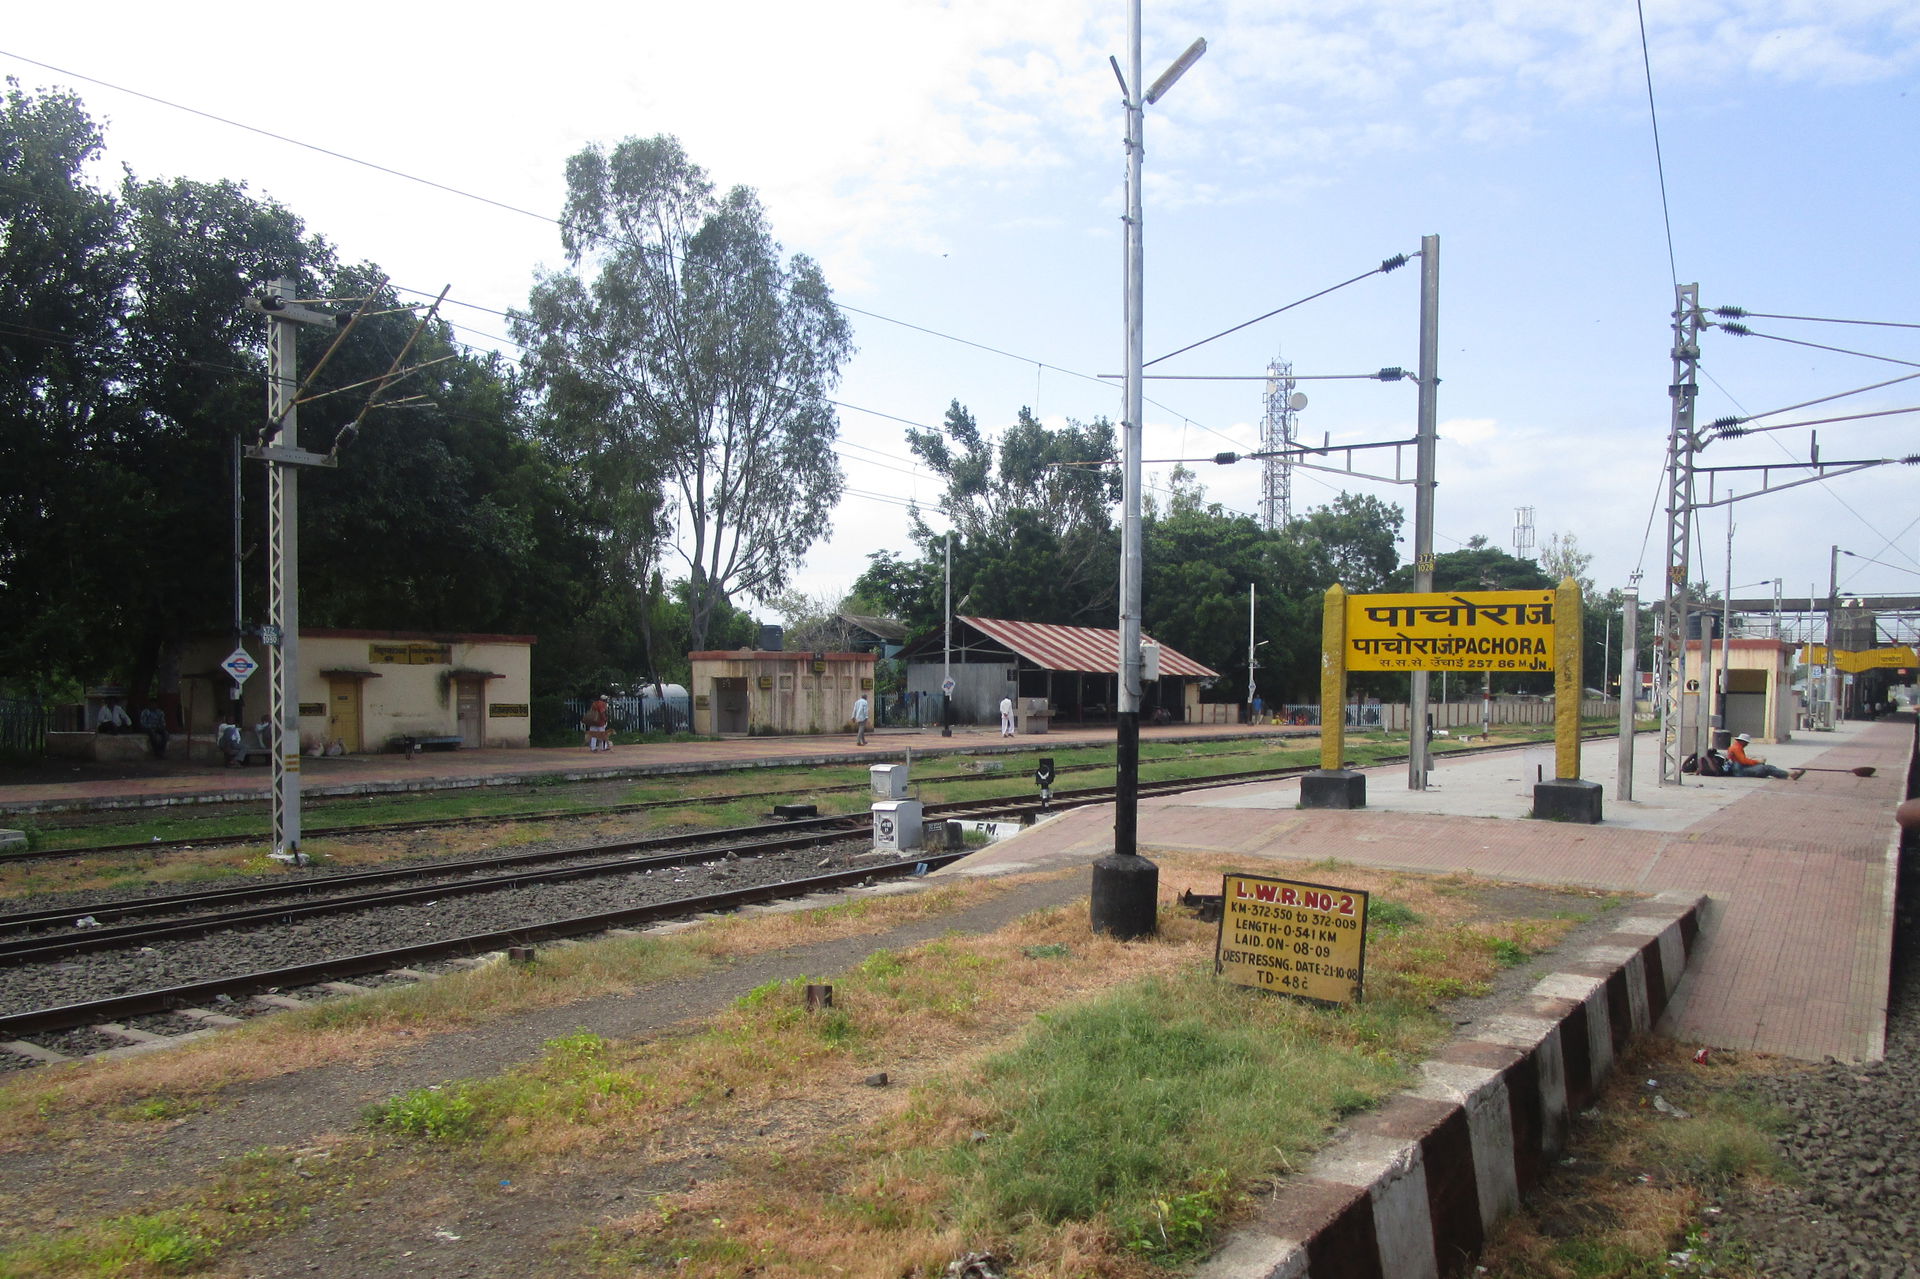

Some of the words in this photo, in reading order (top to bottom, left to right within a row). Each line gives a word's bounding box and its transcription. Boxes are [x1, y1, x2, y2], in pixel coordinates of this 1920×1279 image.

[1419, 554, 1433, 562] 372
[1455, 637, 1547, 655] PACHORA
[1296, 911, 1308, 923] to
[1319, 930, 1337, 943] KM
